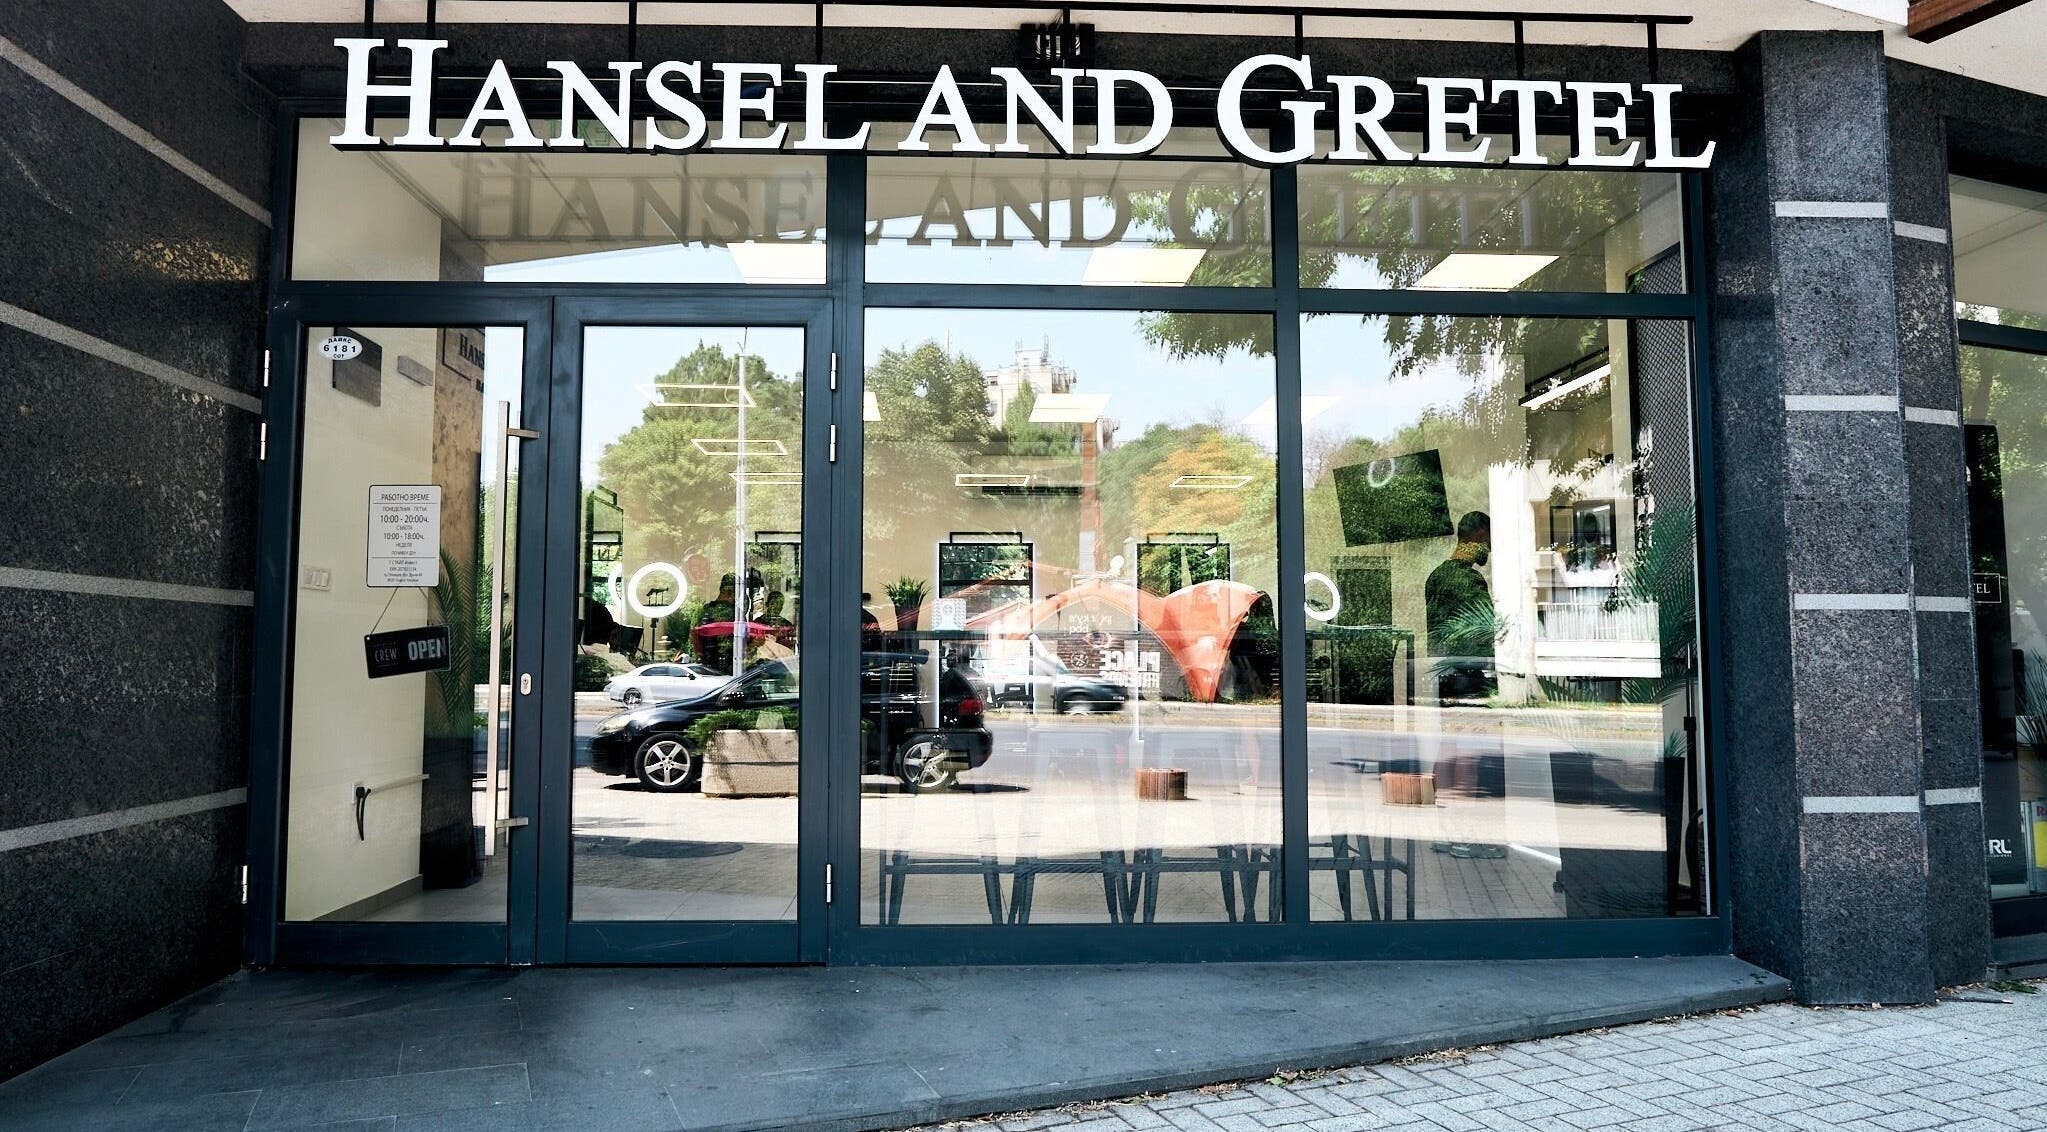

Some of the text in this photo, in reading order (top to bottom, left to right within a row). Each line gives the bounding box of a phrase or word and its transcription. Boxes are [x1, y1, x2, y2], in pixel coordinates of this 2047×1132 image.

[330, 38, 1717, 170] HANSEL AND GRETEL
[381, 493, 430, 501] РАБОТНО ВРЕМЕ
[380, 514, 399, 523] 10:00
[407, 637, 447, 661] OPEN
